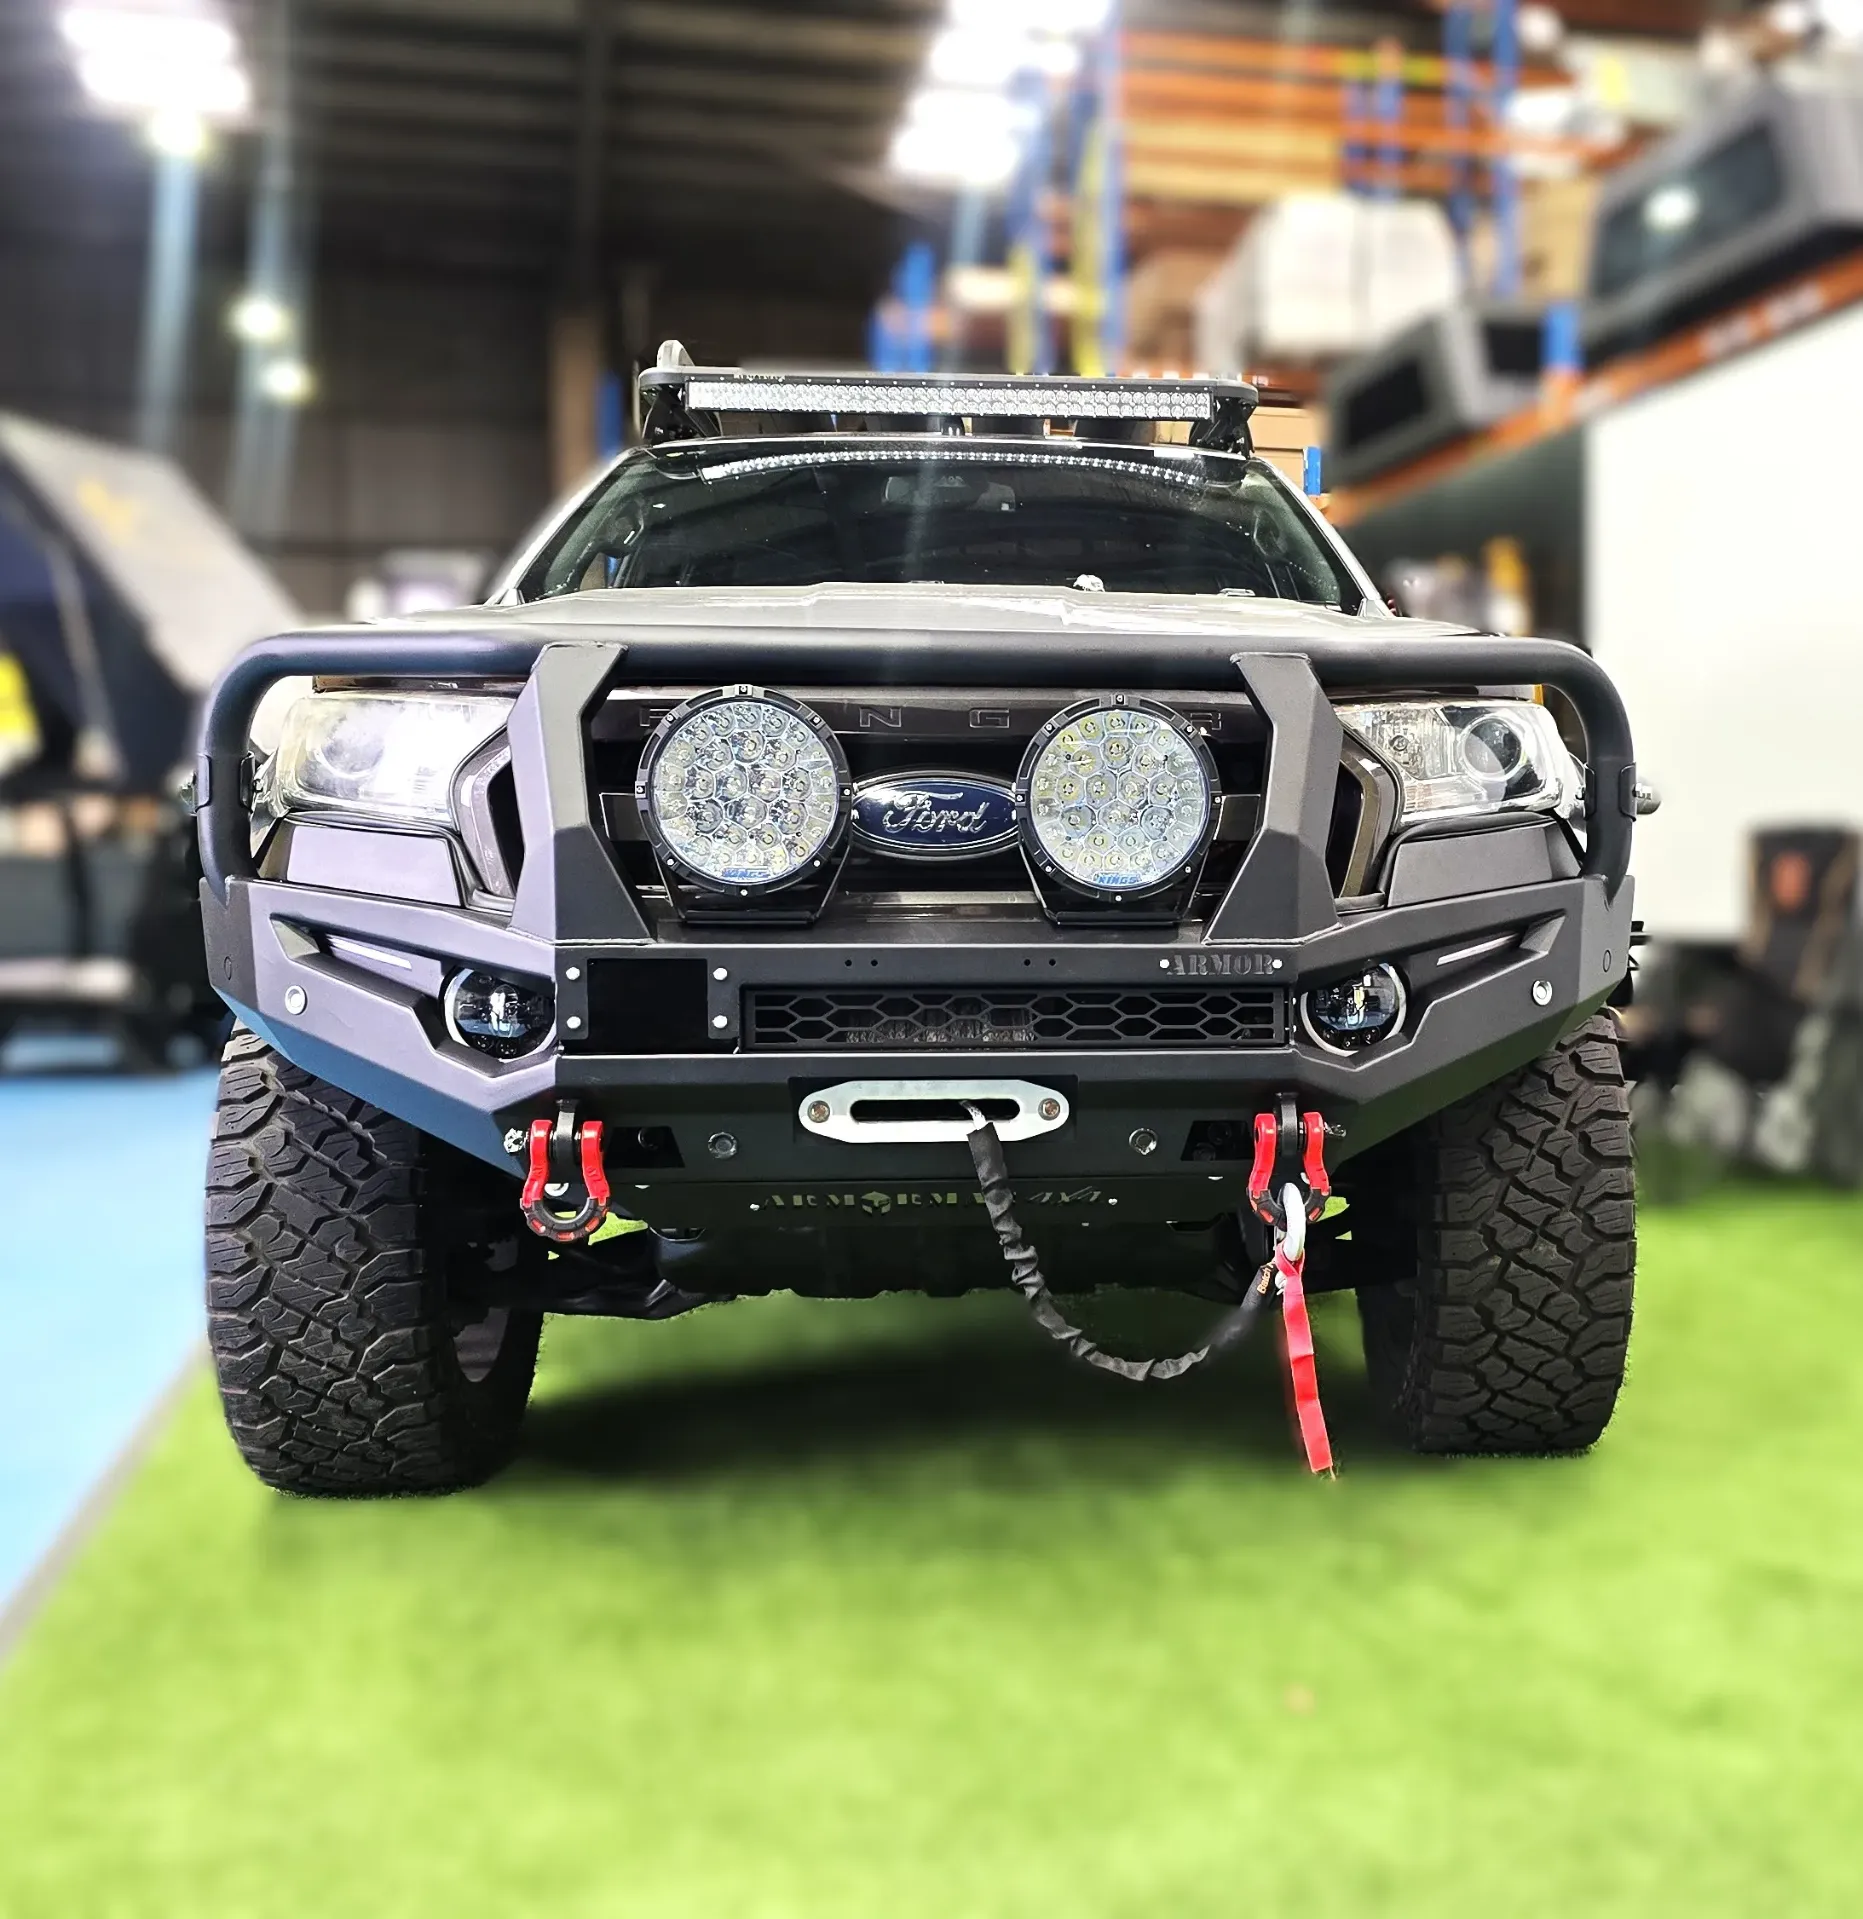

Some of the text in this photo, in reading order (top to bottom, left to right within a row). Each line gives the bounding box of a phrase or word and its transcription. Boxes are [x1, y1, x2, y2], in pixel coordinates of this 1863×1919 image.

[882, 790, 990, 833] Ford
[1096, 872, 1138, 885] KINGS
[1166, 953, 1275, 976] ARMOR
